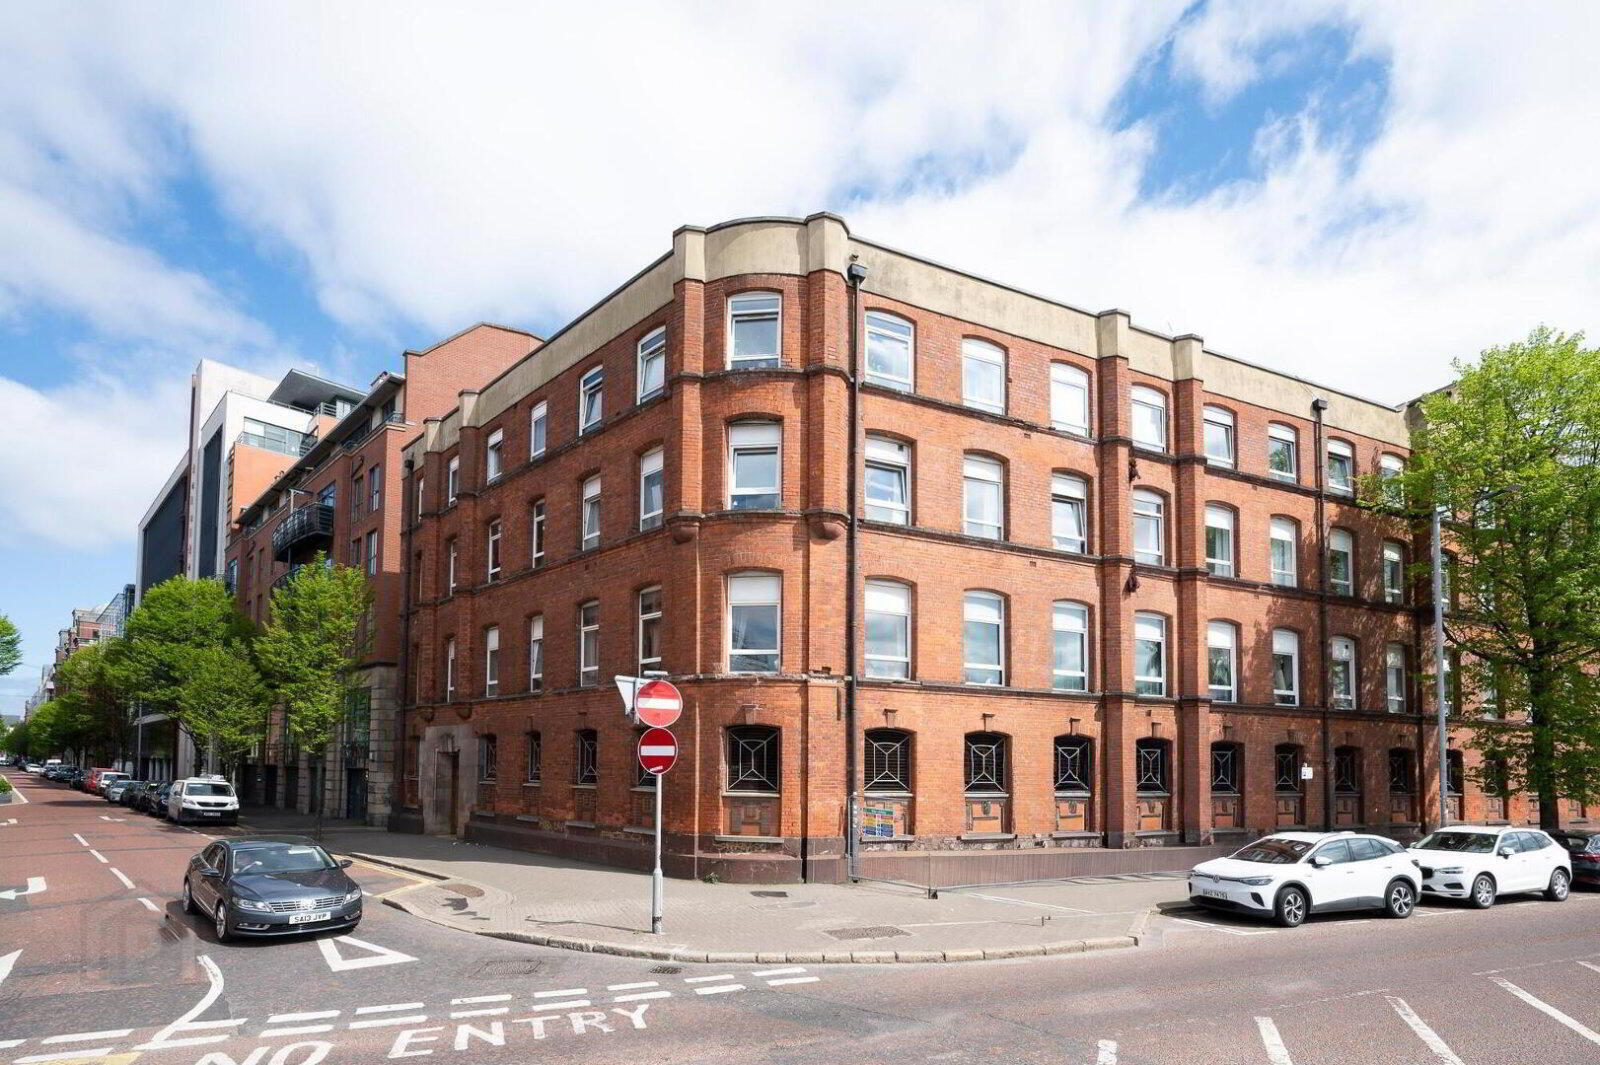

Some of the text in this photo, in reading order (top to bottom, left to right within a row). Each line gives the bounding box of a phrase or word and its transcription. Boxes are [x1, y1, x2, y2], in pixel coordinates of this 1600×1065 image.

[294, 914, 312, 922] SA13
[194, 1003, 647, 1065] NO ENTRY
